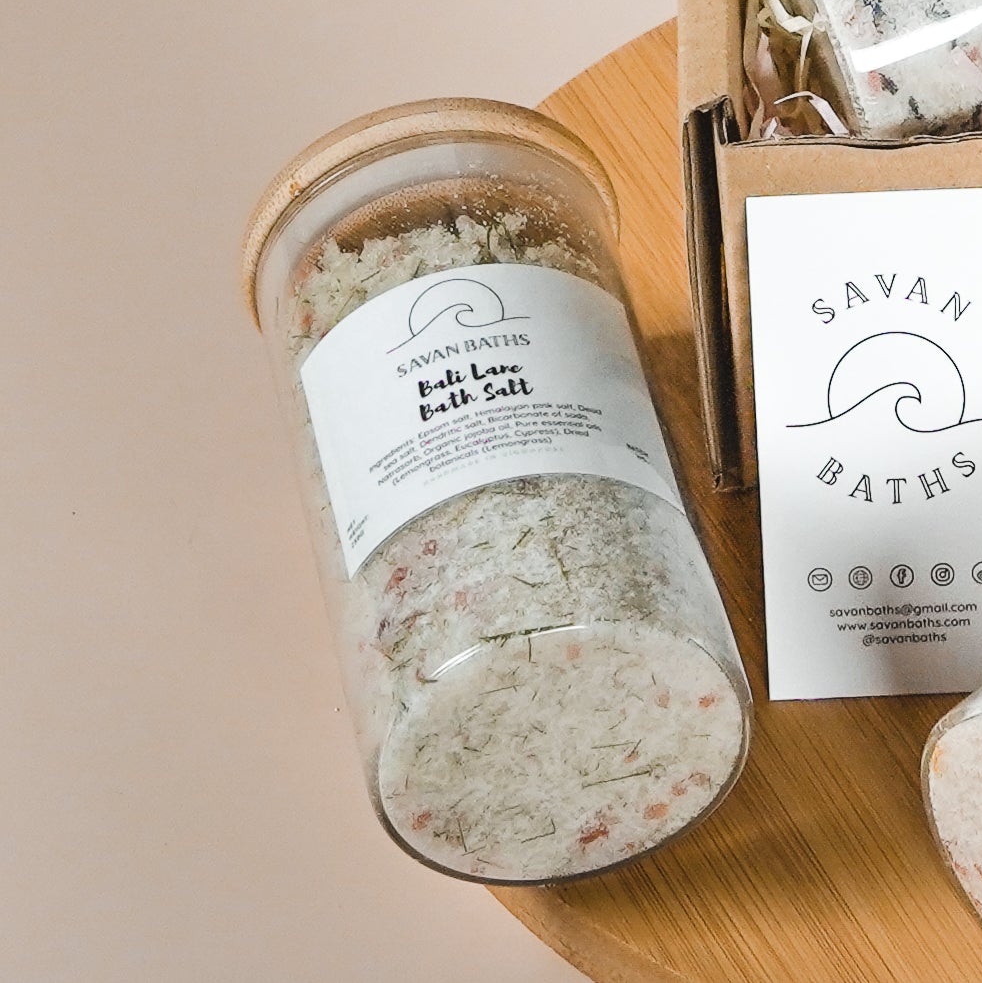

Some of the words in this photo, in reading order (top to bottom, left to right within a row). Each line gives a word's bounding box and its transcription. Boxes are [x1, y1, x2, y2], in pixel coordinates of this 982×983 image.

[812, 273, 971, 324] SAVAN
[397, 343, 459, 377] SAVAN
[464, 333, 531, 352] BATHS
[418, 370, 467, 398] Bali
[419, 388, 478, 421] Bath
[483, 377, 534, 401] Salt
[815, 451, 976, 504] BATHS
[829, 602, 978, 617] savanbaths@gmail.com
[837, 618, 971, 631] www.savanbaths.com
[862, 632, 947, 647] @savanbaths
